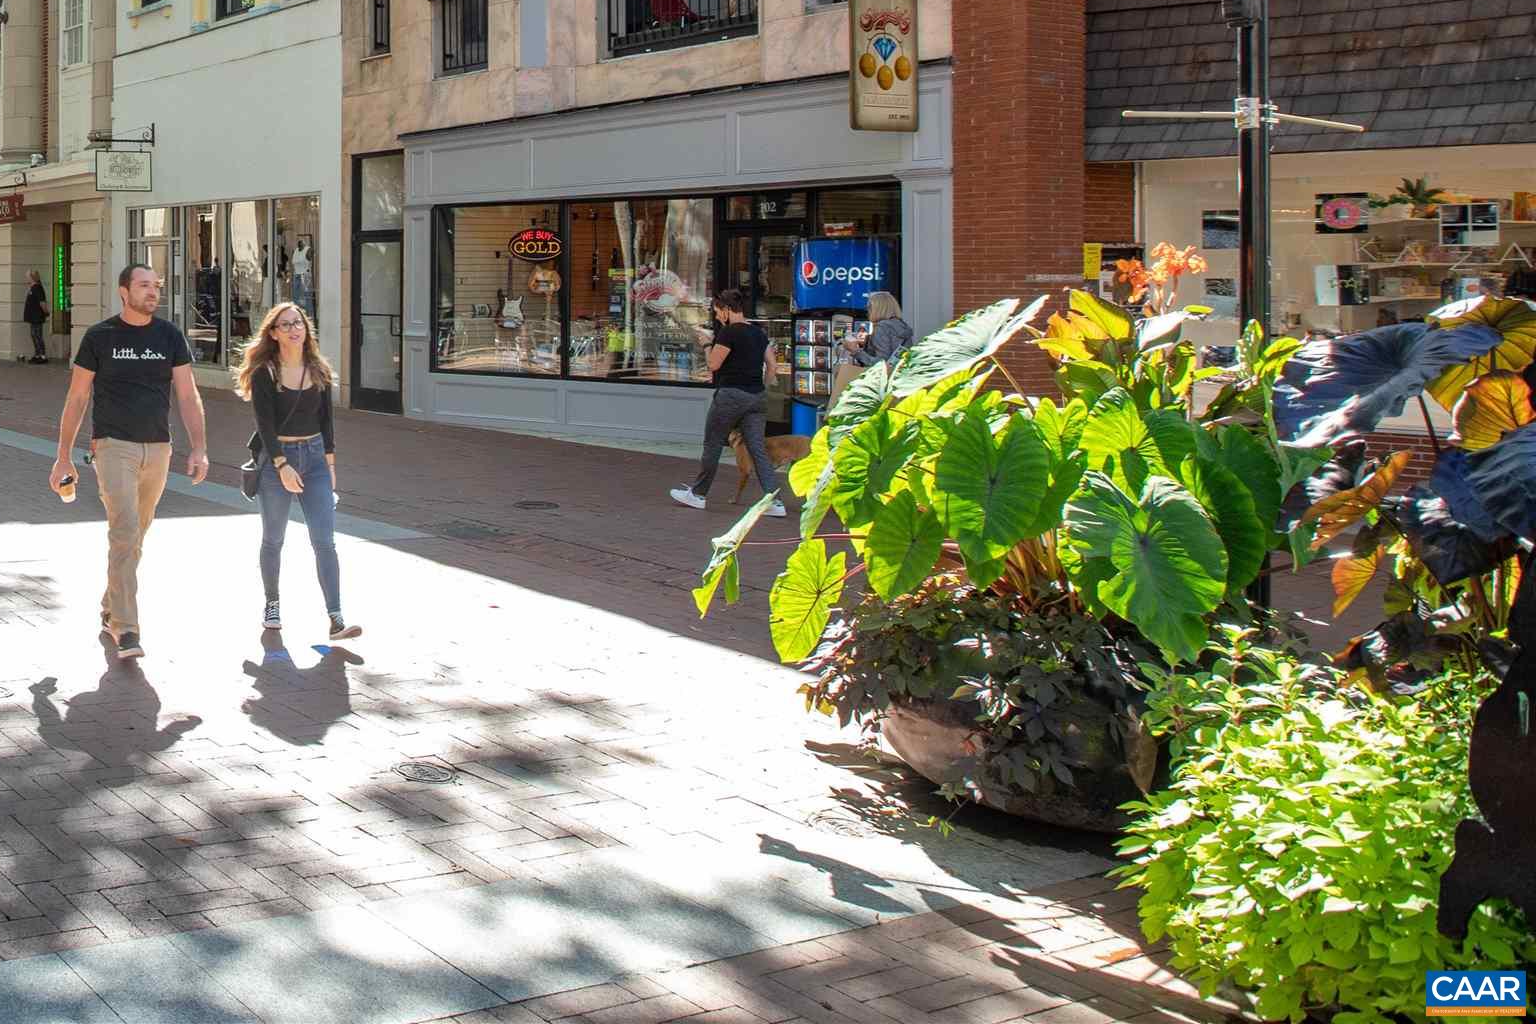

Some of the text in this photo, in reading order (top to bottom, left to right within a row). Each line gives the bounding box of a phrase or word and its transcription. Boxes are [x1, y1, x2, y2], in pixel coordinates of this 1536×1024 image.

[760, 201, 777, 213] 102
[520, 230, 553, 241] WE BUY
[514, 241, 561, 254] GOLD
[822, 263, 880, 285] pepsi
[112, 347, 166, 360] little star
